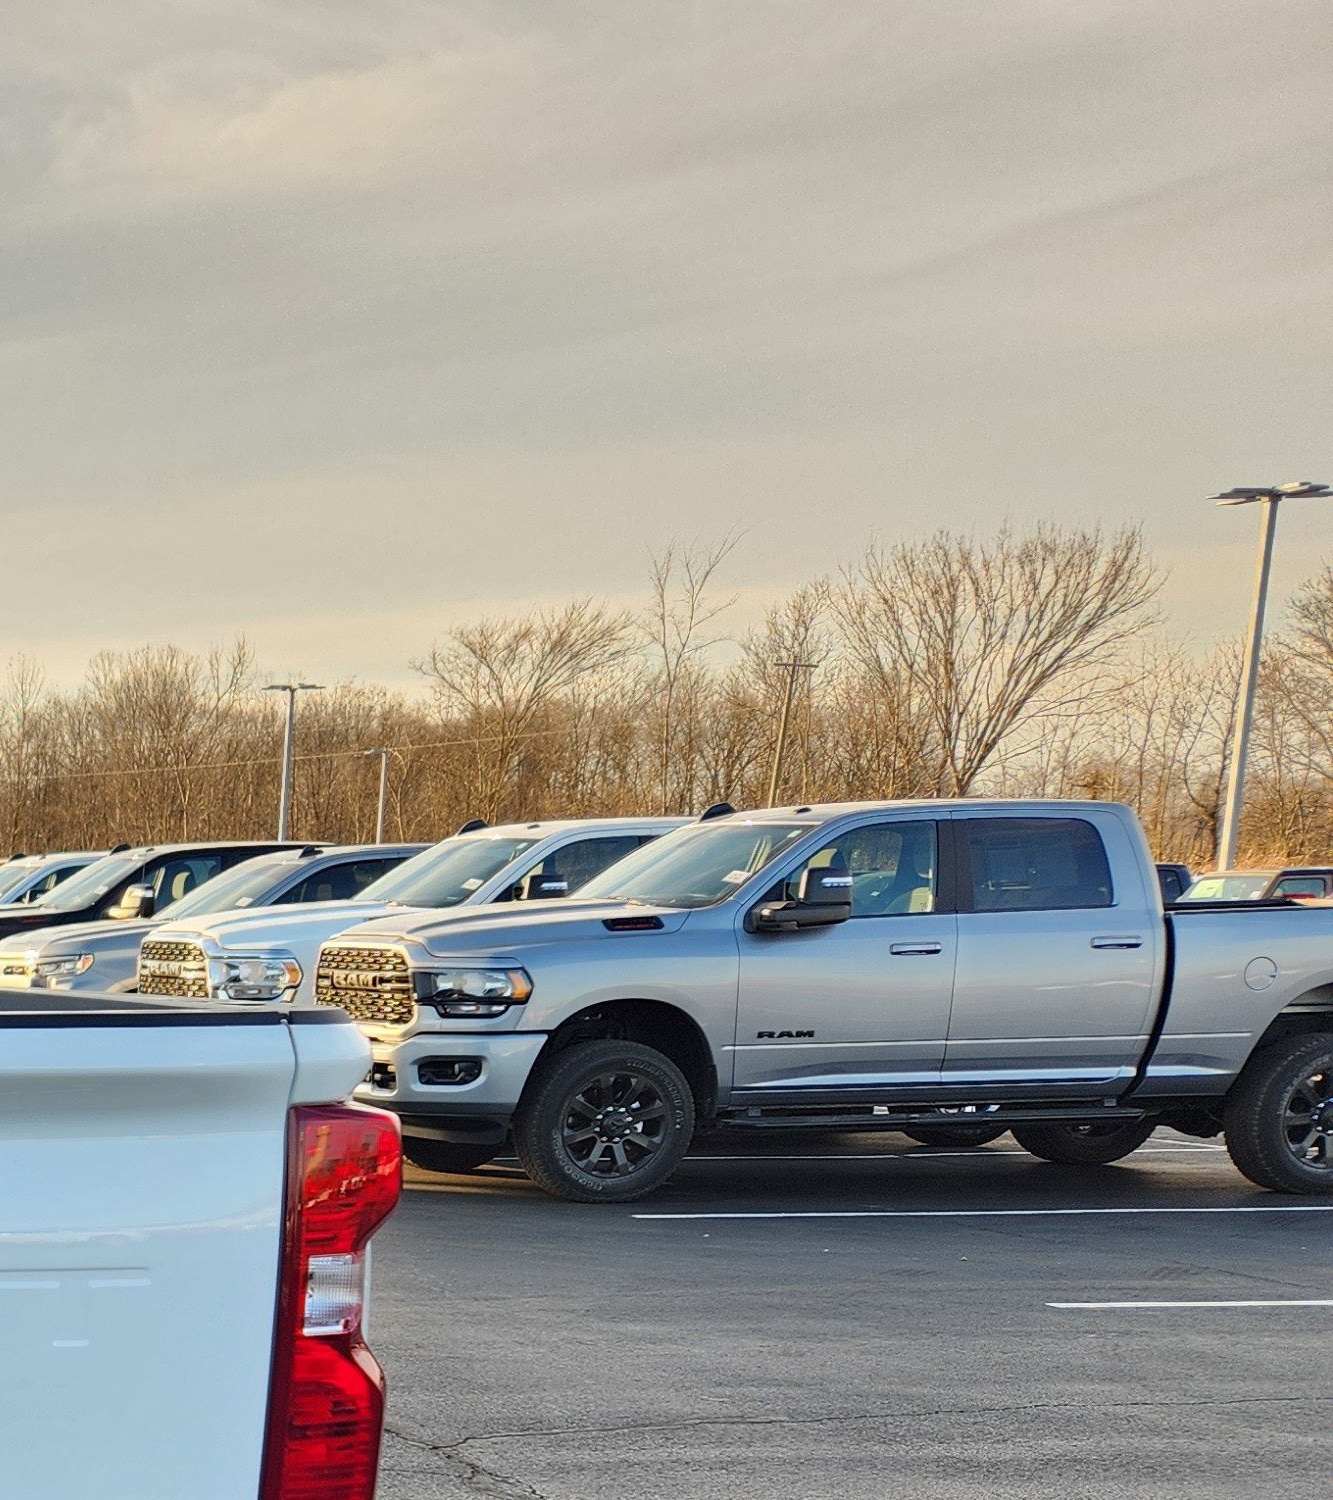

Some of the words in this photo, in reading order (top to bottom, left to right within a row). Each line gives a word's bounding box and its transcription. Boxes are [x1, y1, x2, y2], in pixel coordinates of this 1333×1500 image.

[148, 963, 183, 977] RAM
[332, 971, 375, 988] RAM
[757, 1030, 815, 1039] RAM
